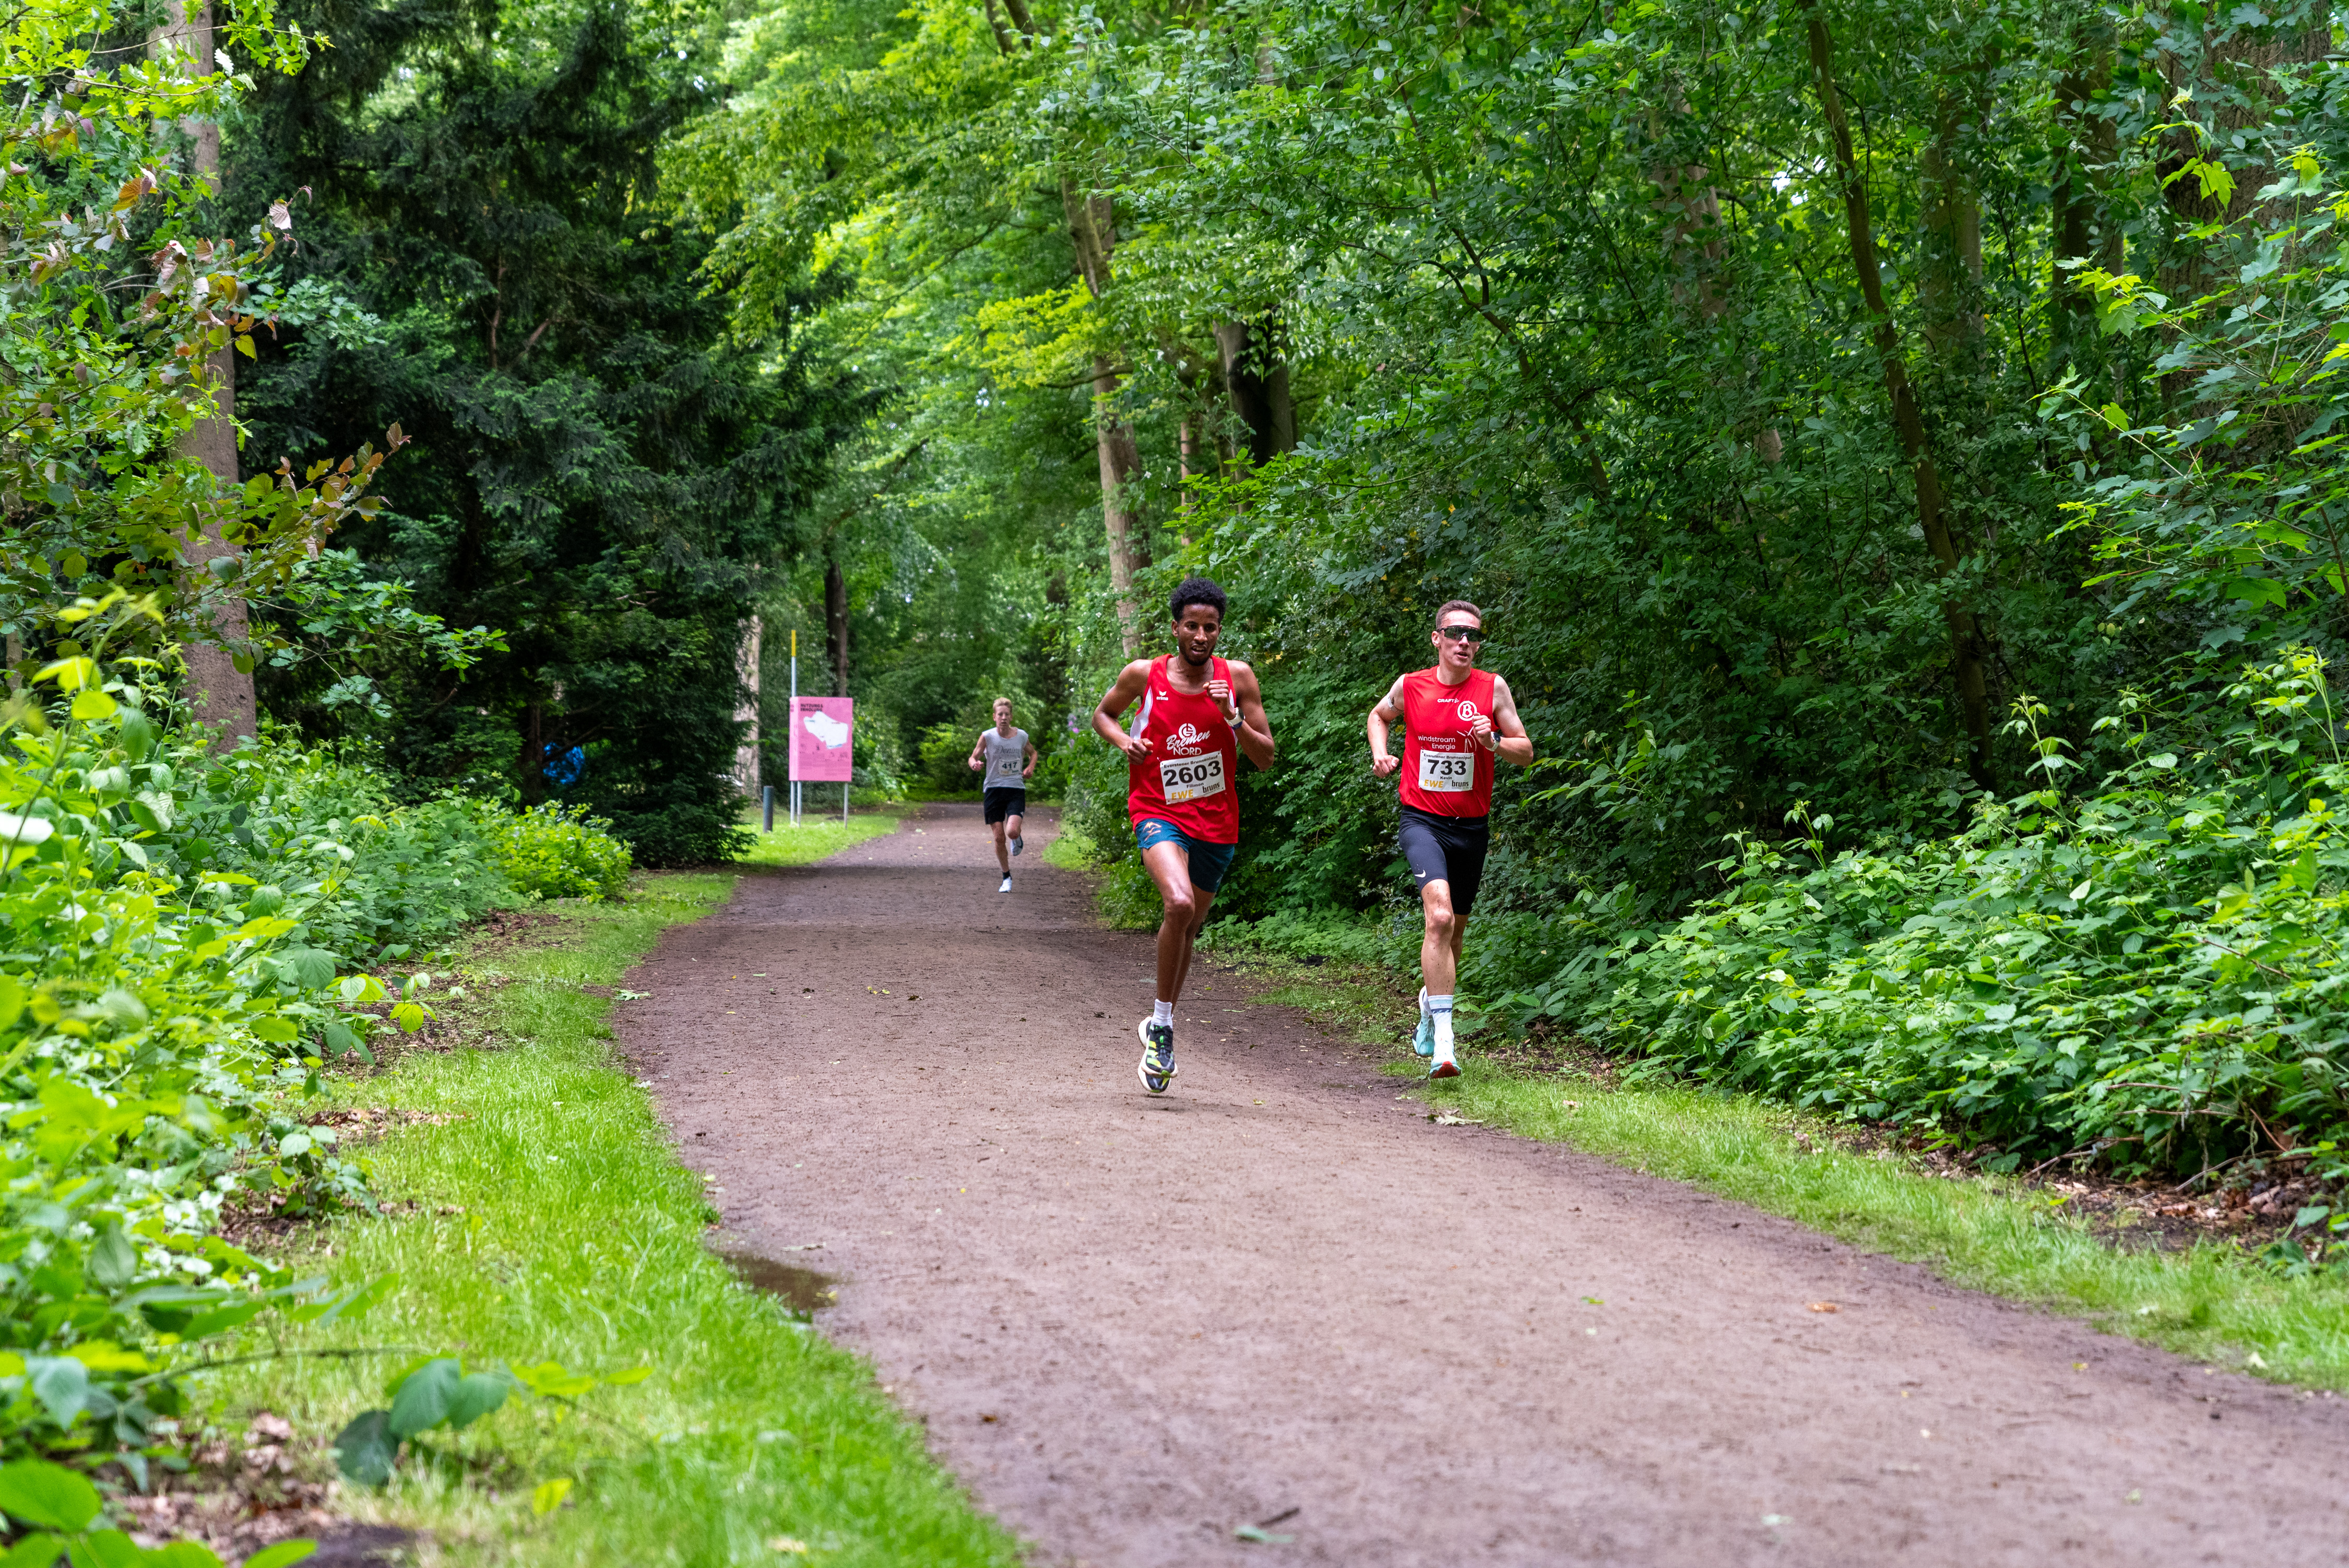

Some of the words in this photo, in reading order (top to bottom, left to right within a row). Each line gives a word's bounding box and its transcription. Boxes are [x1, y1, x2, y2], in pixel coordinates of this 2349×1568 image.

[1166, 730, 1211, 750] Bremen
[1173, 747, 1202, 755] NORD
[1190, 755, 1218, 765] Brunnenlauf
[1428, 759, 1466, 776] 733
[1163, 760, 1221, 787] 2603
[1202, 782, 1220, 793] bruns
[1424, 779, 1443, 788] EWE
[1171, 789, 1193, 800] EWE
